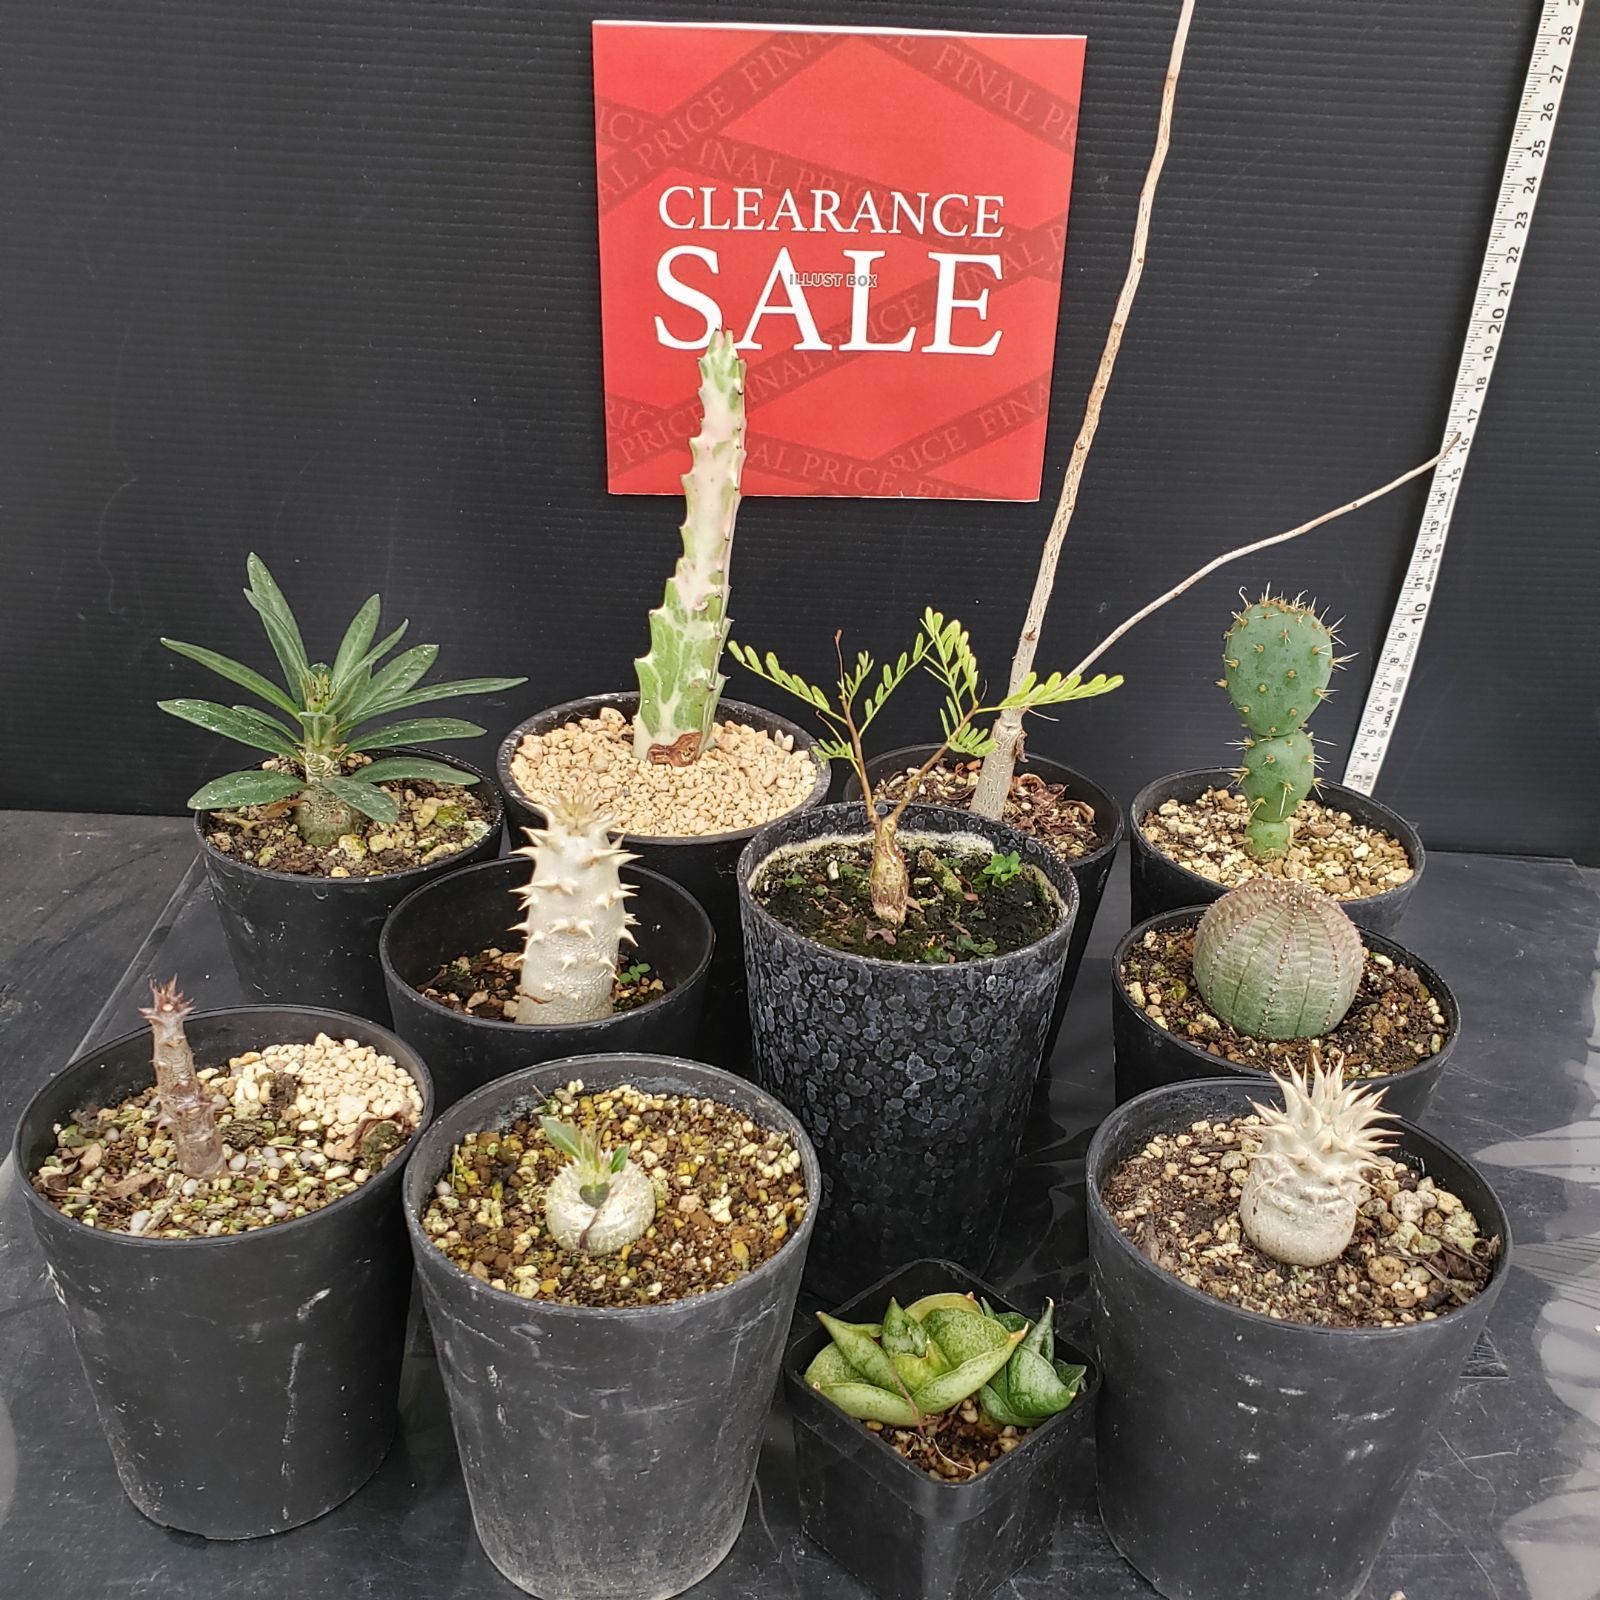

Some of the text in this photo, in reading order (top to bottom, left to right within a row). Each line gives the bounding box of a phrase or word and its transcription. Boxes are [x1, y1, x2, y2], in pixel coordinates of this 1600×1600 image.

[1558, 25, 1573, 46] 28
[933, 43, 1034, 122] FINAL
[1549, 64, 1564, 84] 27
[1540, 102, 1555, 122] 26
[632, 86, 735, 170] PRICE
[1531, 139, 1546, 158] 25
[1522, 176, 1537, 194] 24
[658, 185, 1005, 239] CLEARANCE
[1514, 211, 1528, 229] 23
[1506, 246, 1520, 264] 22
[789, 273, 878, 288] ILLUST BOX
[1498, 281, 1511, 297] 21
[654, 245, 1004, 356] SALE
[1488, 308, 1505, 334] 20
[1483, 345, 1495, 362] 19
[1475, 376, 1487, 393] 18
[1467, 408, 1478, 423] 17
[1458, 437, 1470, 453] 16
[1451, 467, 1462, 482] 15
[1437, 491, 1447, 504] 14
[1429, 520, 1440, 533] 13
[1422, 548, 1433, 560] 12
[1414, 576, 1424, 587] 11
[1411, 603, 1427, 624] 10
